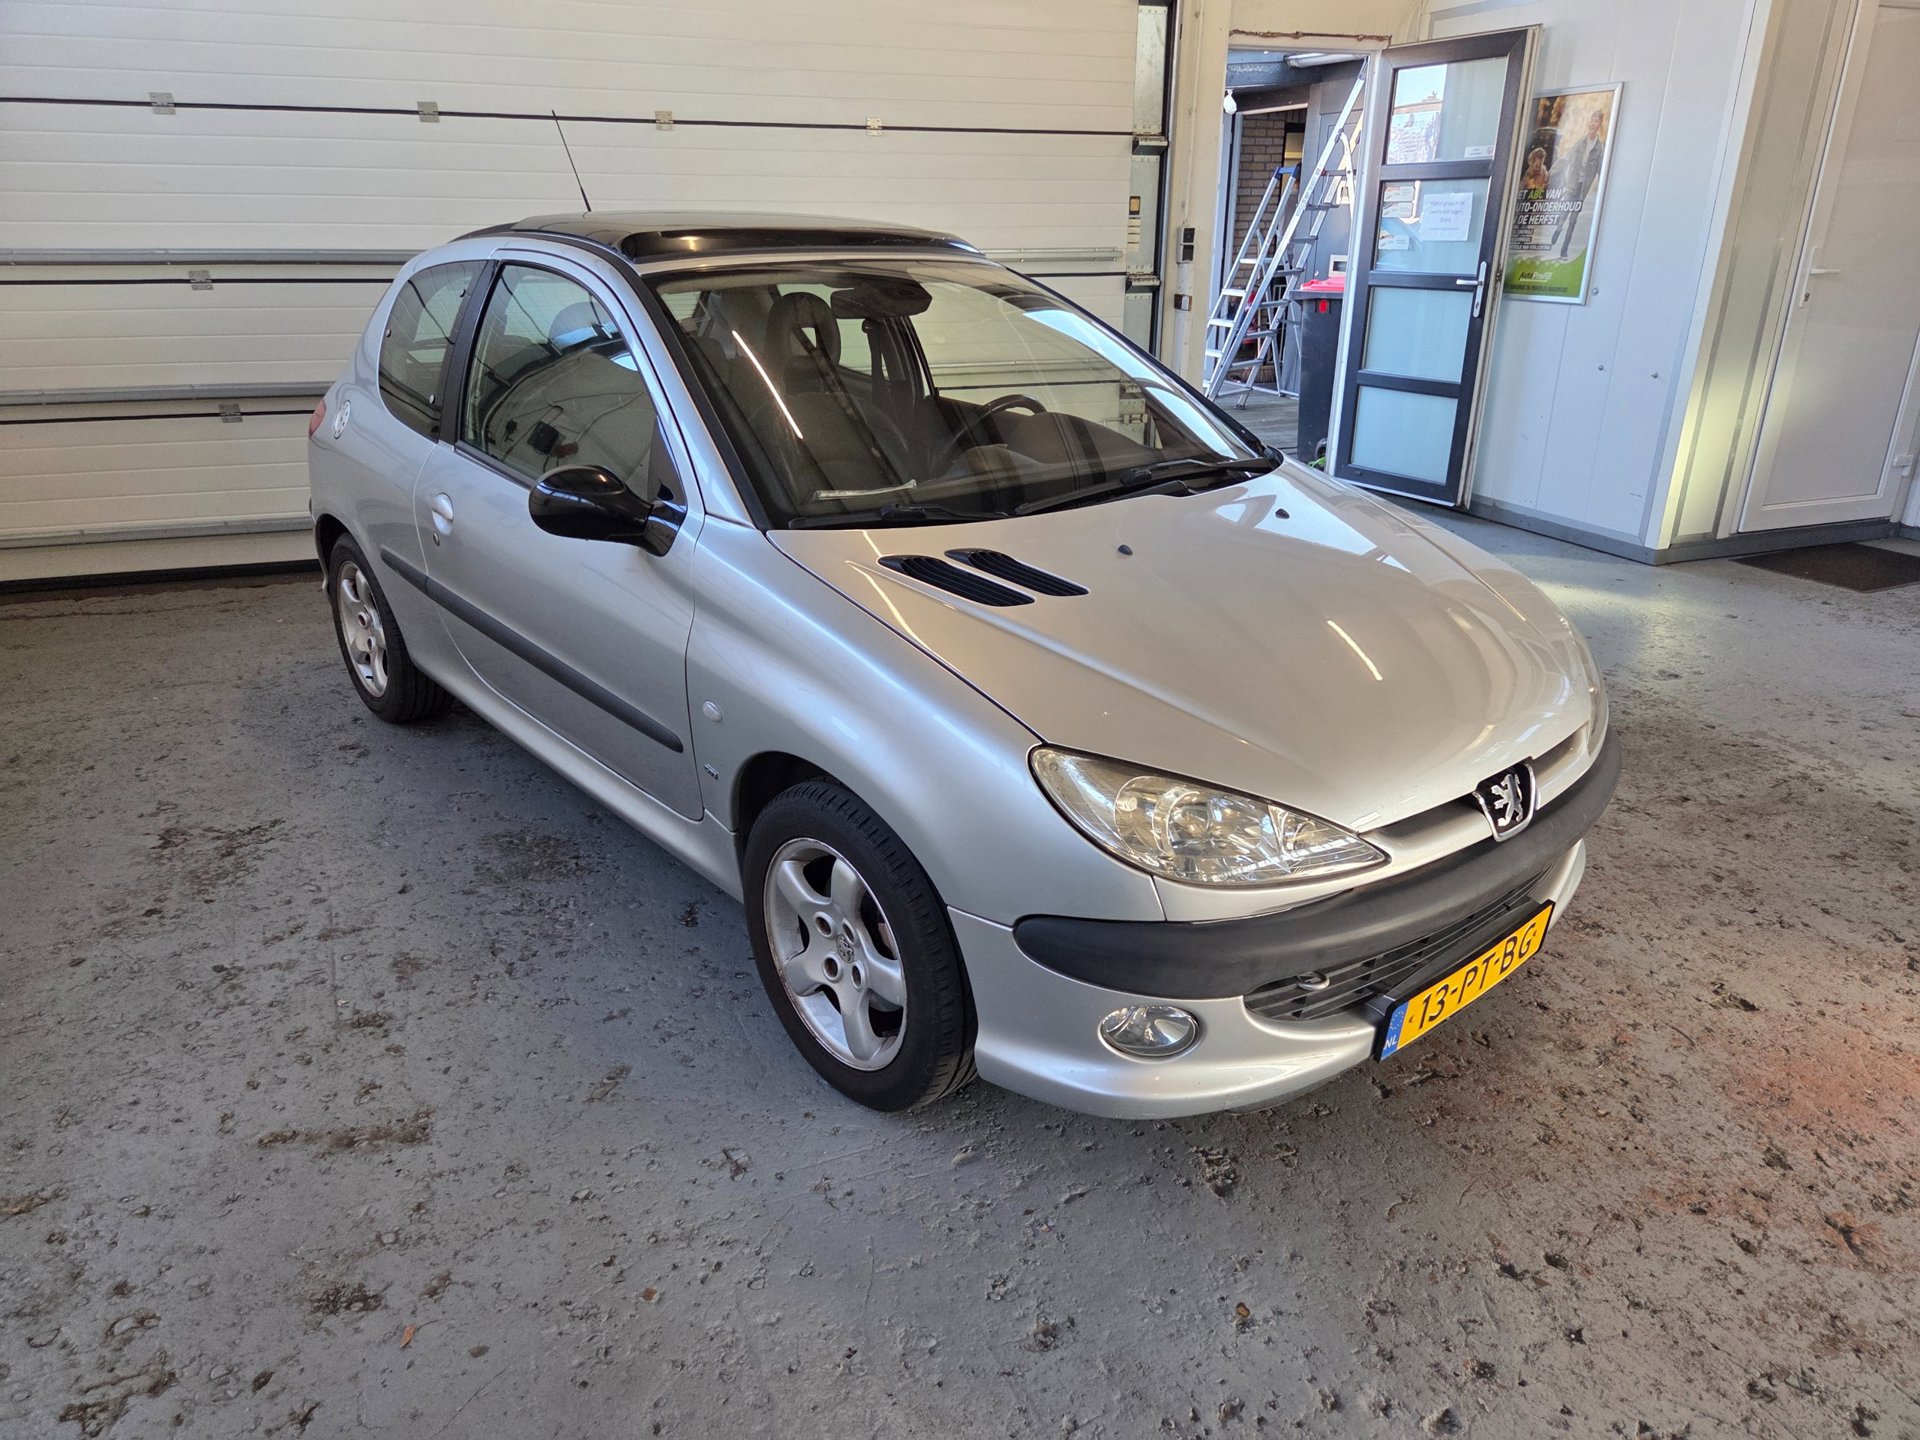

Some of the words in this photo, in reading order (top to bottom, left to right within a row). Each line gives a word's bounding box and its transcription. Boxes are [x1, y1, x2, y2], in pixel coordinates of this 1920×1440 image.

[1518, 189, 1528, 200] ET
[1528, 189, 1544, 199] ABC
[1545, 189, 1561, 199] VAN
[1515, 201, 1582, 212] UTO-ONDERHOUD
[1518, 215, 1528, 225] DE
[1528, 214, 1559, 225] HERFST
[1418, 922, 1537, 1030] 13-PT-BG
[1384, 1035, 1397, 1050] NL
